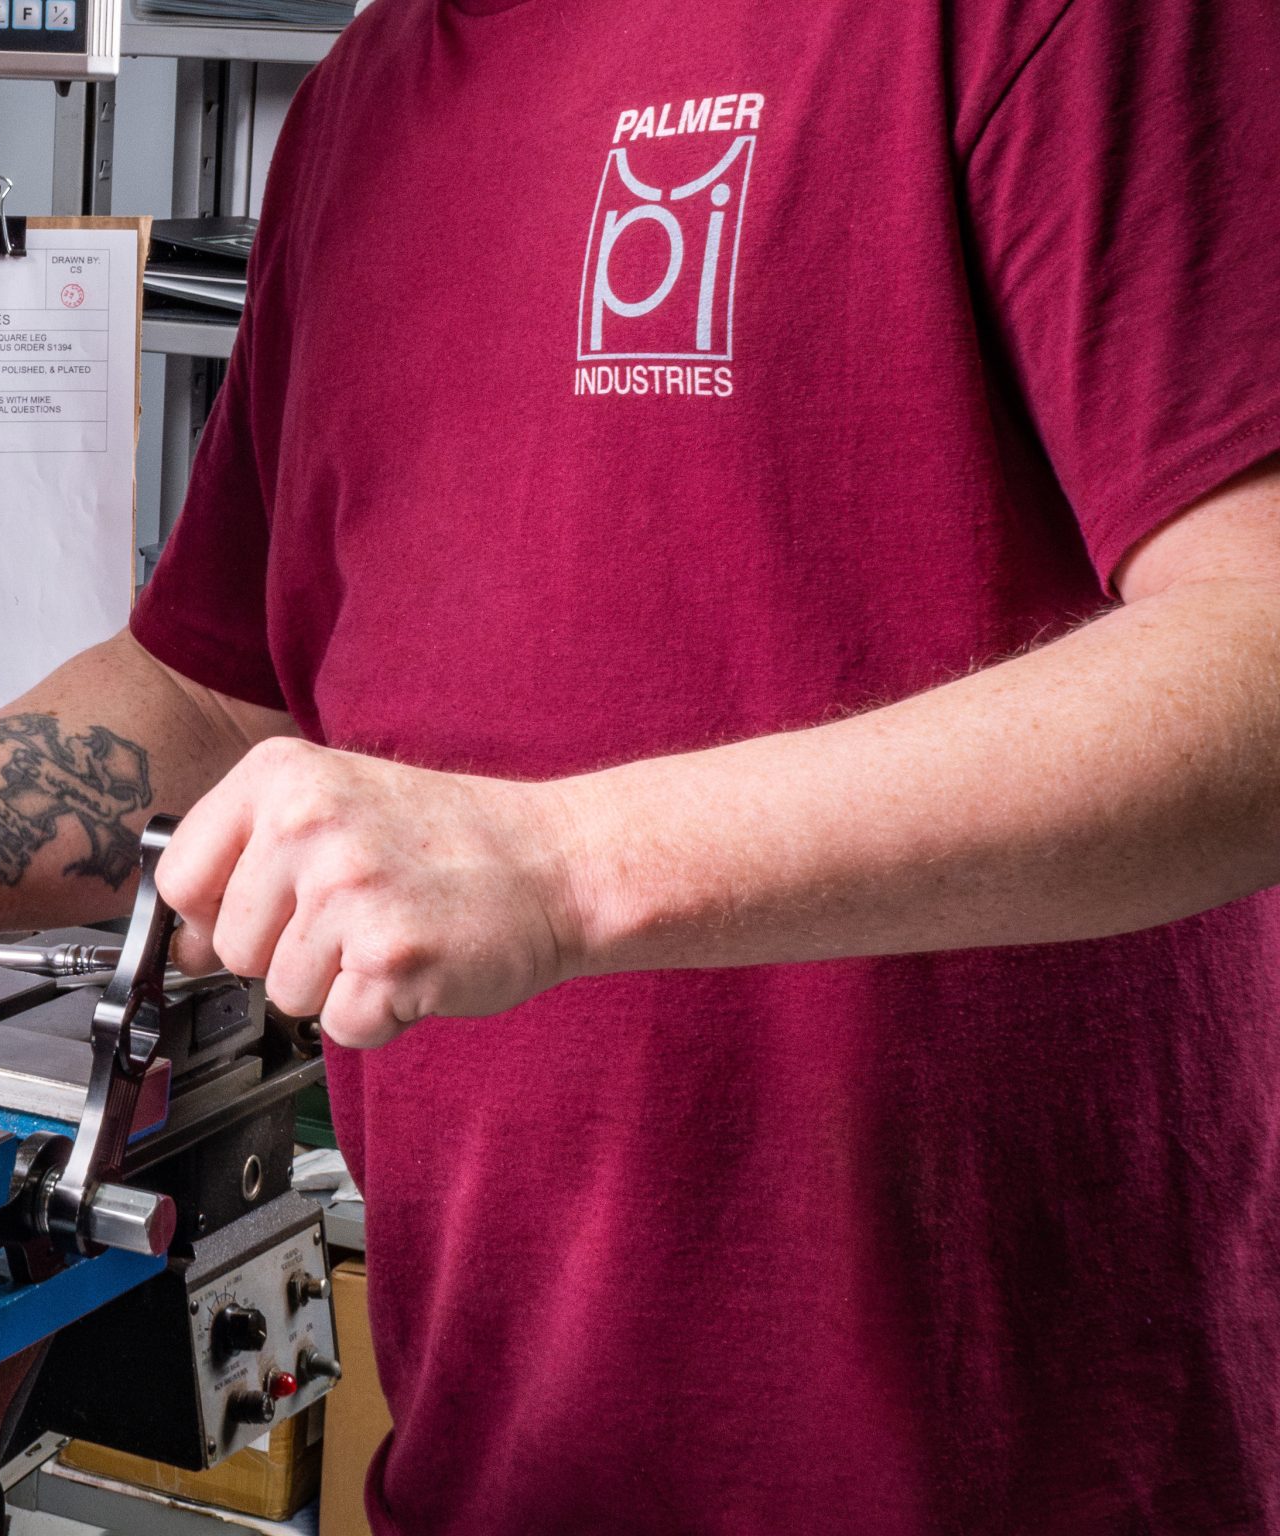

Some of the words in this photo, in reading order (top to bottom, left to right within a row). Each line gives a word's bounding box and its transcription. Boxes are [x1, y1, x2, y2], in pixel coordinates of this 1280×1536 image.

[23, 7, 33, 21] F
[612, 92, 765, 144] PALMER
[51, 256, 85, 265] DRAWN
[87, 256, 101, 265] BY:
[69, 266, 82, 274] CS
[30, 334, 47, 342] LEG
[14, 343, 45, 351] ORDER
[46, 343, 72, 351] S1394
[1, 366, 48, 375] POLISHED,
[49, 366, 56, 374] &
[57, 366, 91, 374] PLATED
[574, 365, 734, 398] INDUSTRIES
[6, 396, 28, 404] WITH
[30, 396, 51, 404] MIKE
[10, 406, 62, 414] QUESTIONS
